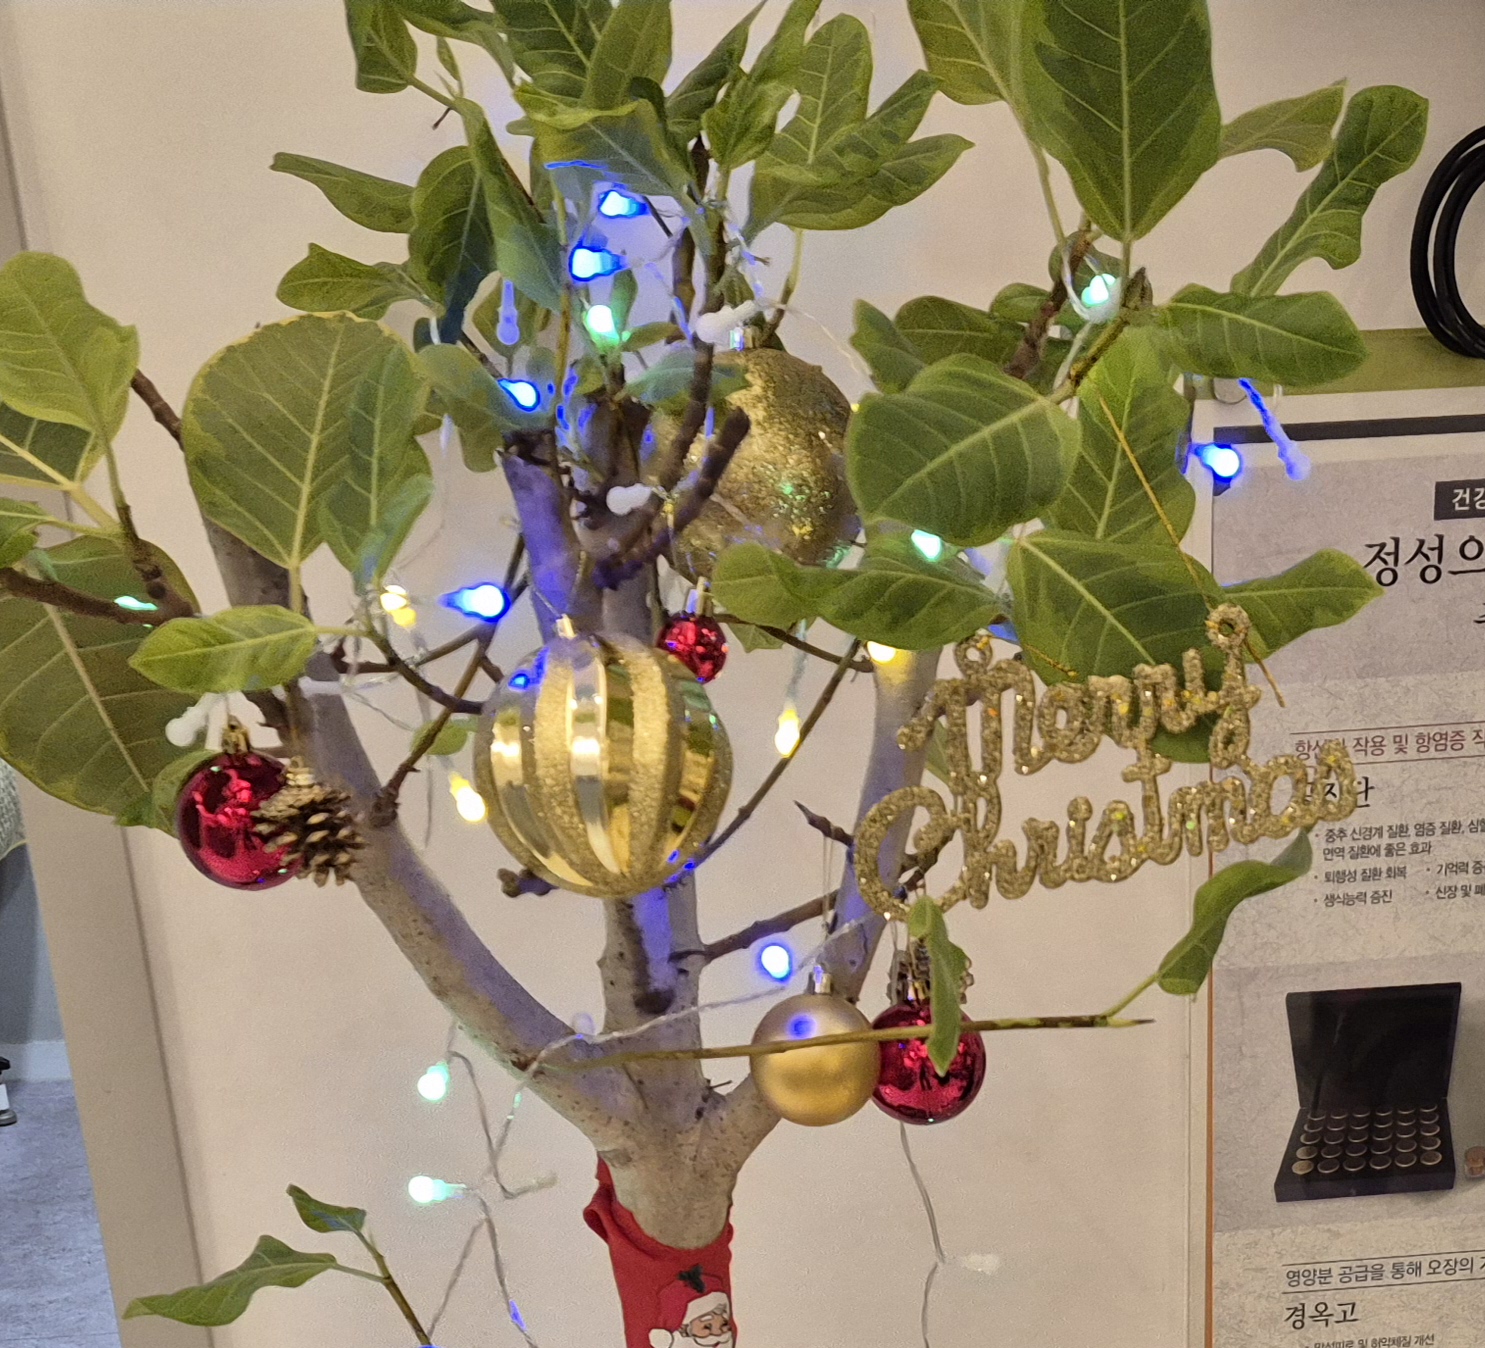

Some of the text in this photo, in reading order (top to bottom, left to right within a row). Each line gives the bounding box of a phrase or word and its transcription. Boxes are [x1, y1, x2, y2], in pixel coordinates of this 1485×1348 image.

[1352, 734, 1387, 757] 작용
[1393, 733, 1408, 754] 및
[1415, 729, 1466, 753] 항염증
[854, 742, 1358, 922] Christmas
[1350, 825, 1383, 841] 신경계
[1413, 821, 1436, 837] 염증
[1286, 1267, 1333, 1288] 영양분
[1337, 1263, 1385, 1285] 공급을
[1390, 1261, 1422, 1280] 통해
[1426, 1257, 1474, 1277] 오장의
[1284, 1301, 1360, 1330] 경옥고
